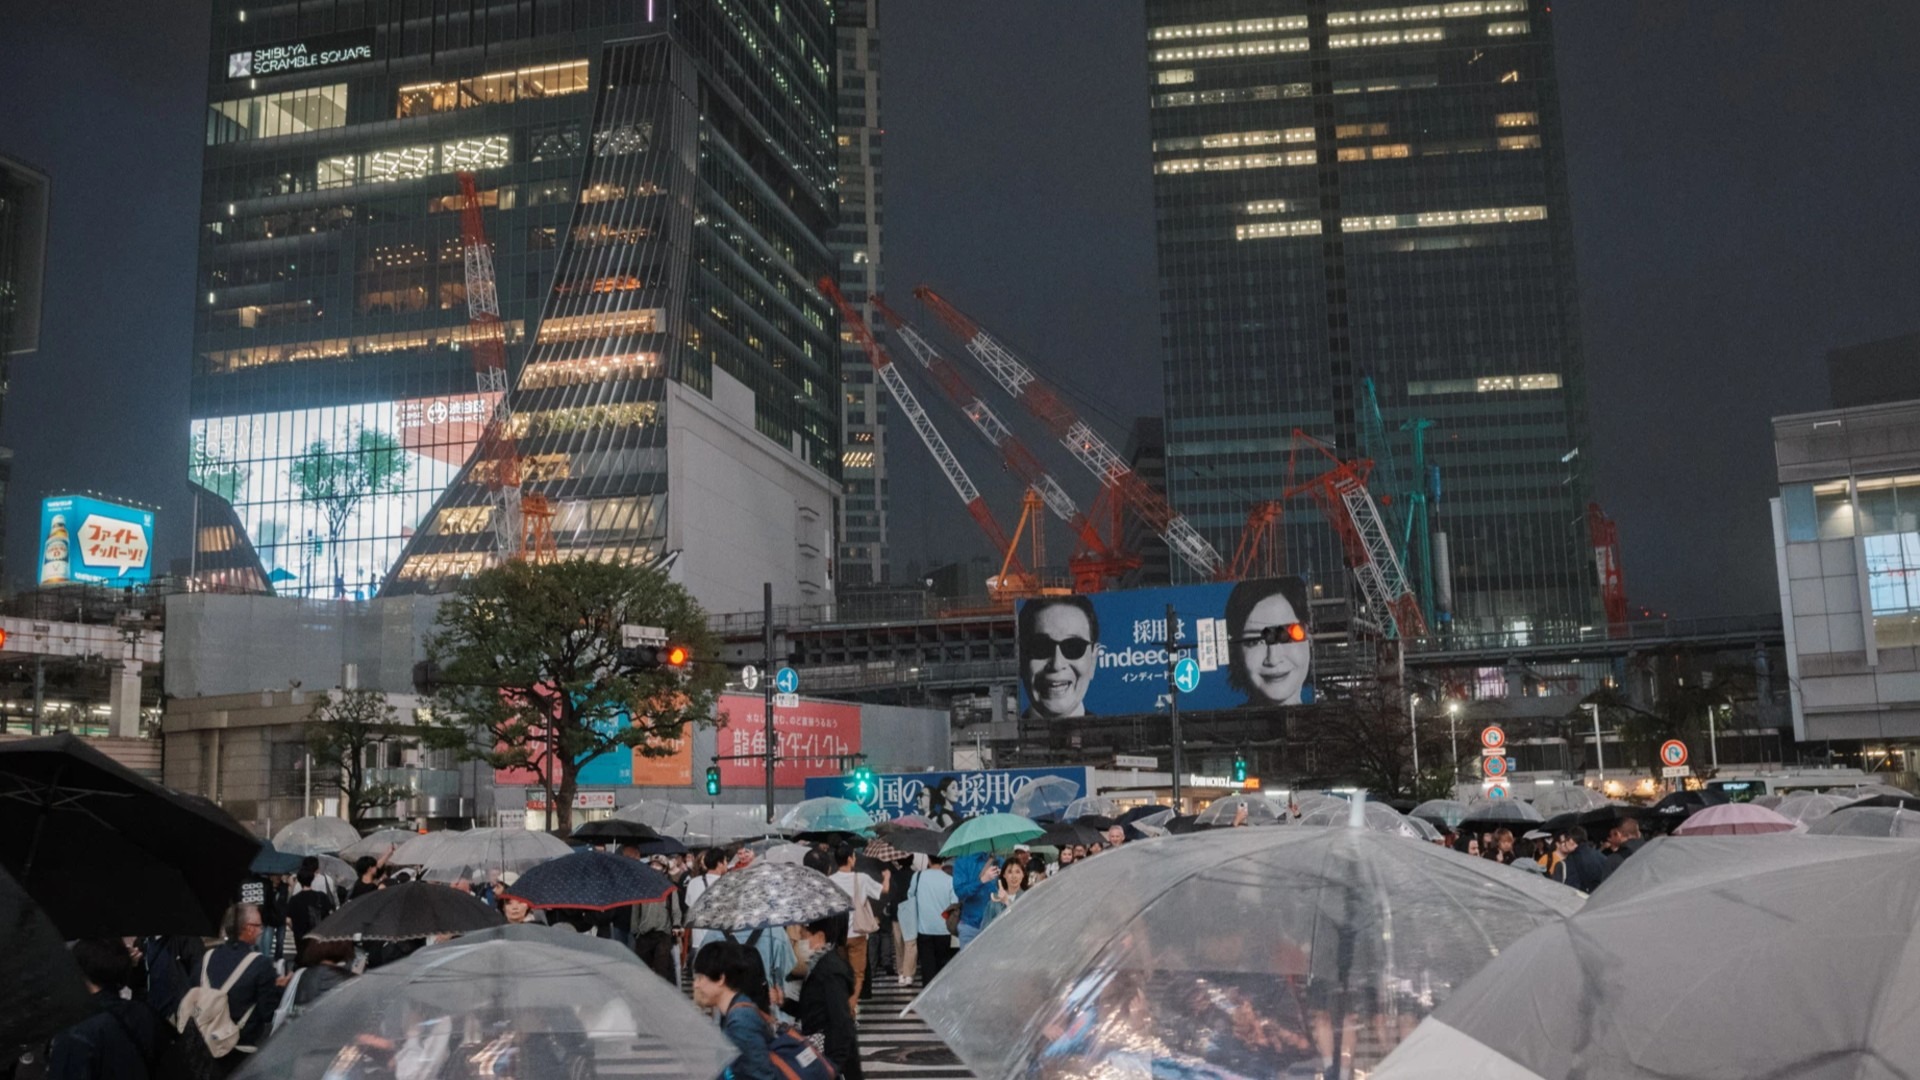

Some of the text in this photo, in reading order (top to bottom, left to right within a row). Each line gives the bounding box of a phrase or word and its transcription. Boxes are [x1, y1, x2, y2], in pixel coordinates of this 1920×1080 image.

[254, 43, 307, 62] SHIBUYA
[254, 45, 371, 74] SCRAMBLE SQUARE
[195, 420, 263, 443] SHIBUYA
[194, 459, 241, 478] WALK
[88, 524, 138, 545] ファイト
[88, 544, 143, 562] イッパーツ!
[746, 713, 839, 729] 水なし飲む、のど直接うるおう
